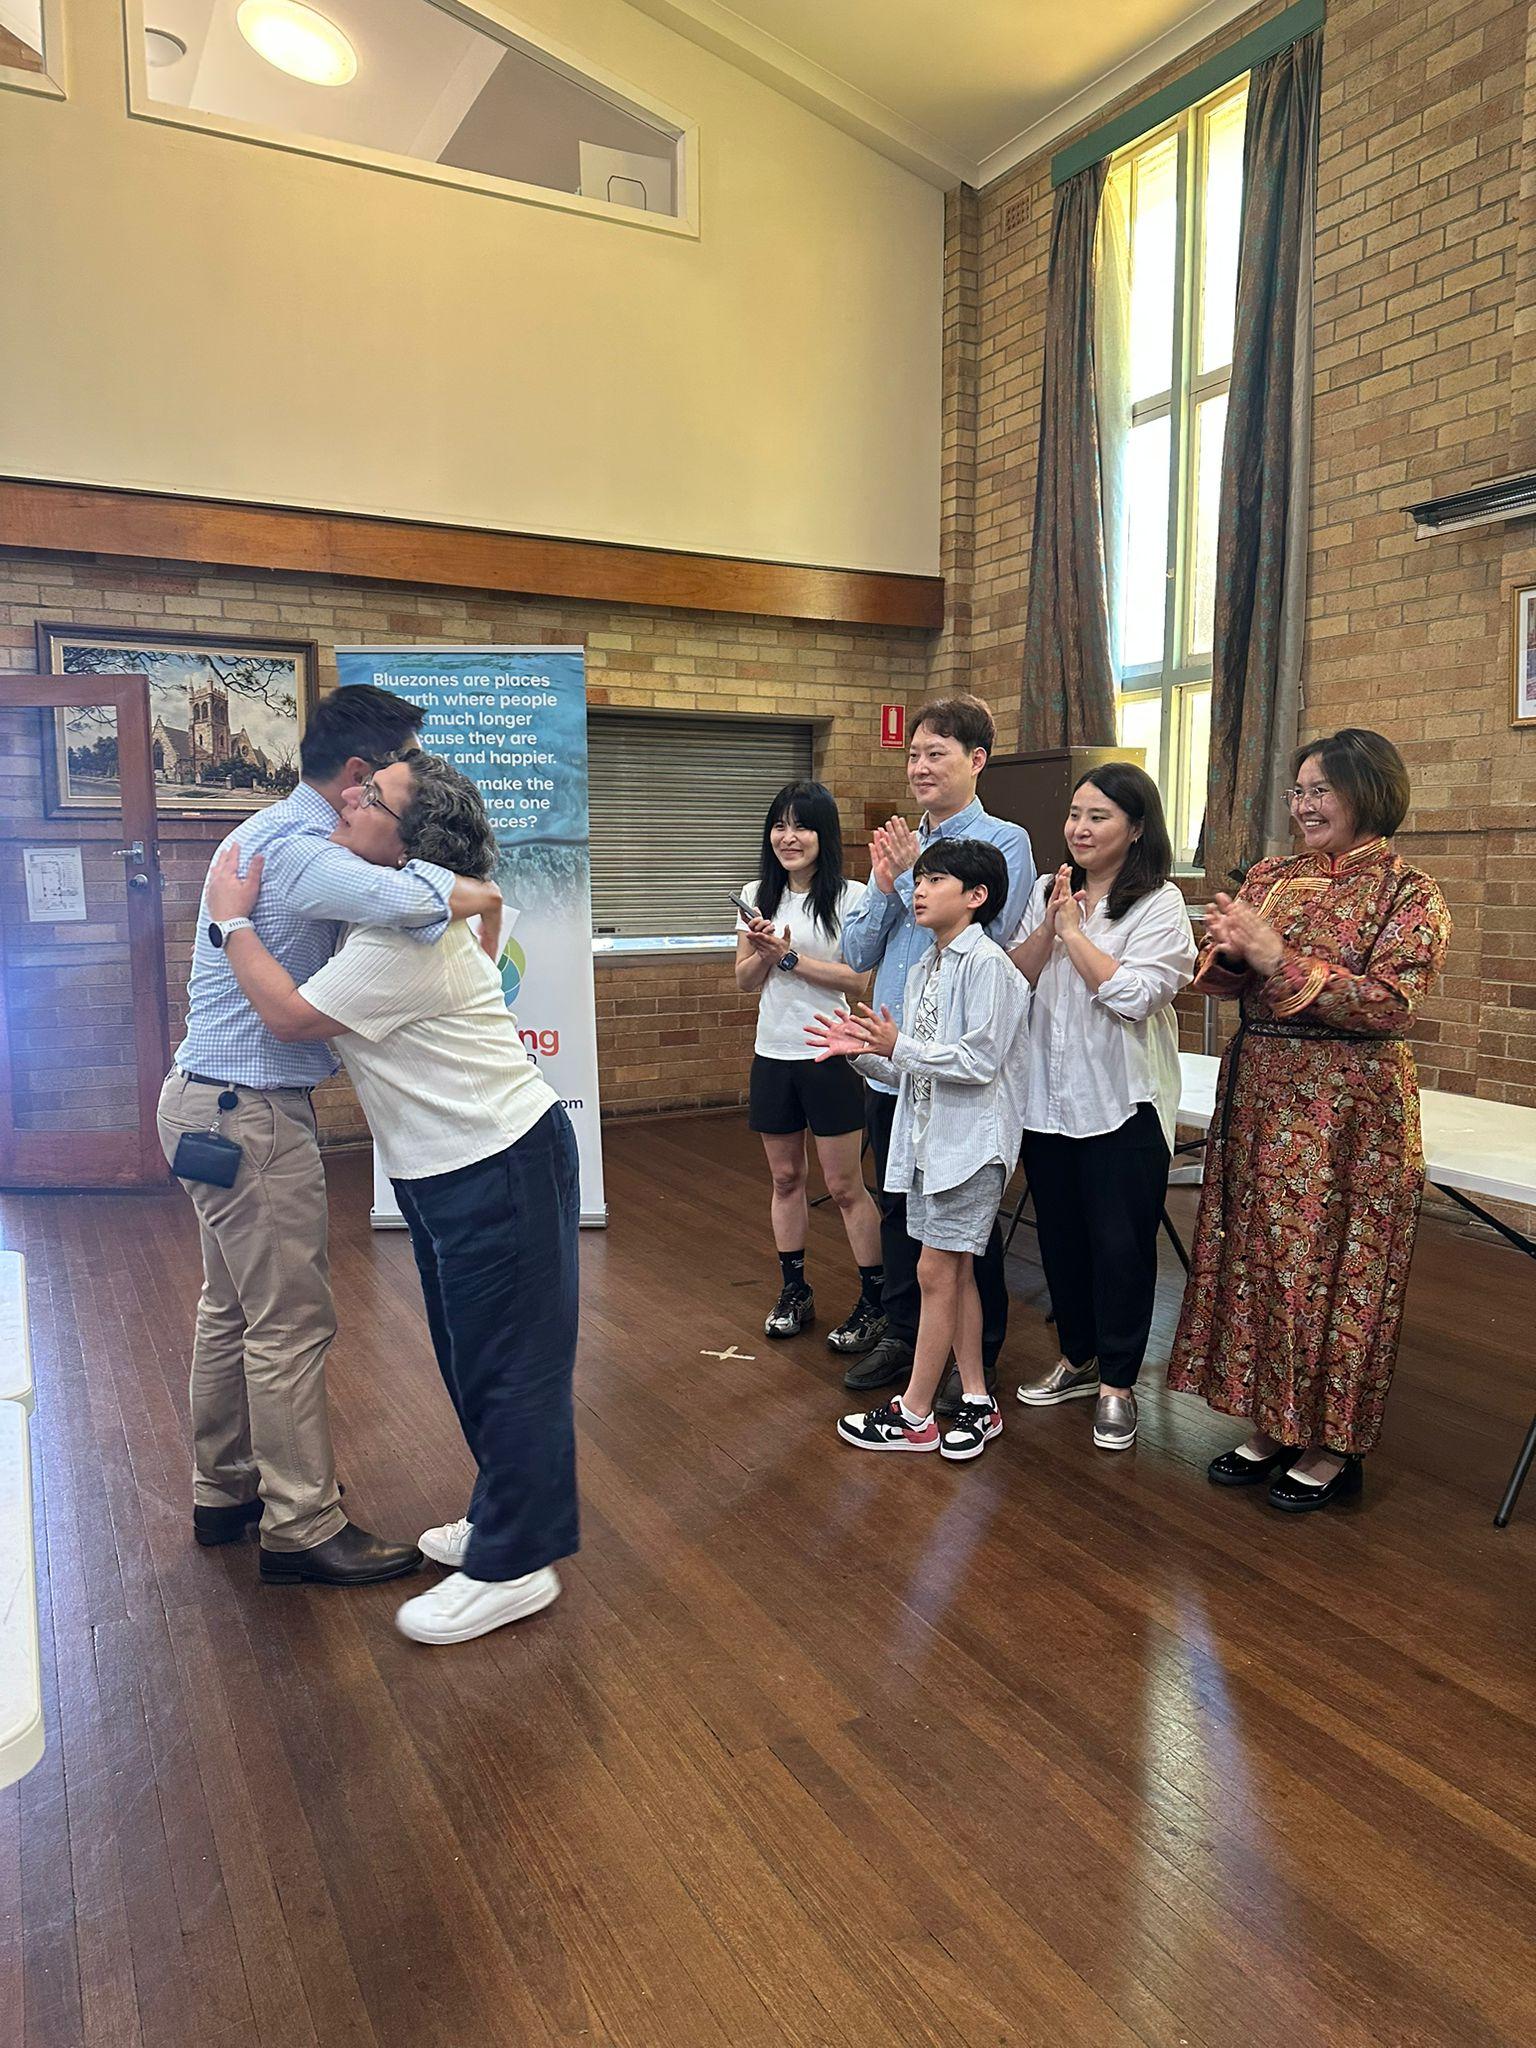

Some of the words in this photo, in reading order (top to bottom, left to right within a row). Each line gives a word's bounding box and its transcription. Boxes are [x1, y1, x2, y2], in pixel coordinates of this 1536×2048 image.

[373, 672, 459, 687] Bluezones
[463, 674, 490, 687] are
[494, 672, 551, 689] places
[395, 692, 439, 706] arth
[443, 692, 495, 706] where
[500, 692, 558, 709] people
[428, 711, 475, 726] much
[479, 711, 532, 729] longer
[468, 731, 506, 747] they
[510, 733, 538, 745] are
[454, 750, 486, 764] and
[489, 750, 557, 767] happier.
[476, 776, 523, 791] make
[526, 776, 555, 791] the
[519, 798, 551, 810] one
[488, 815, 538, 828] aces?
